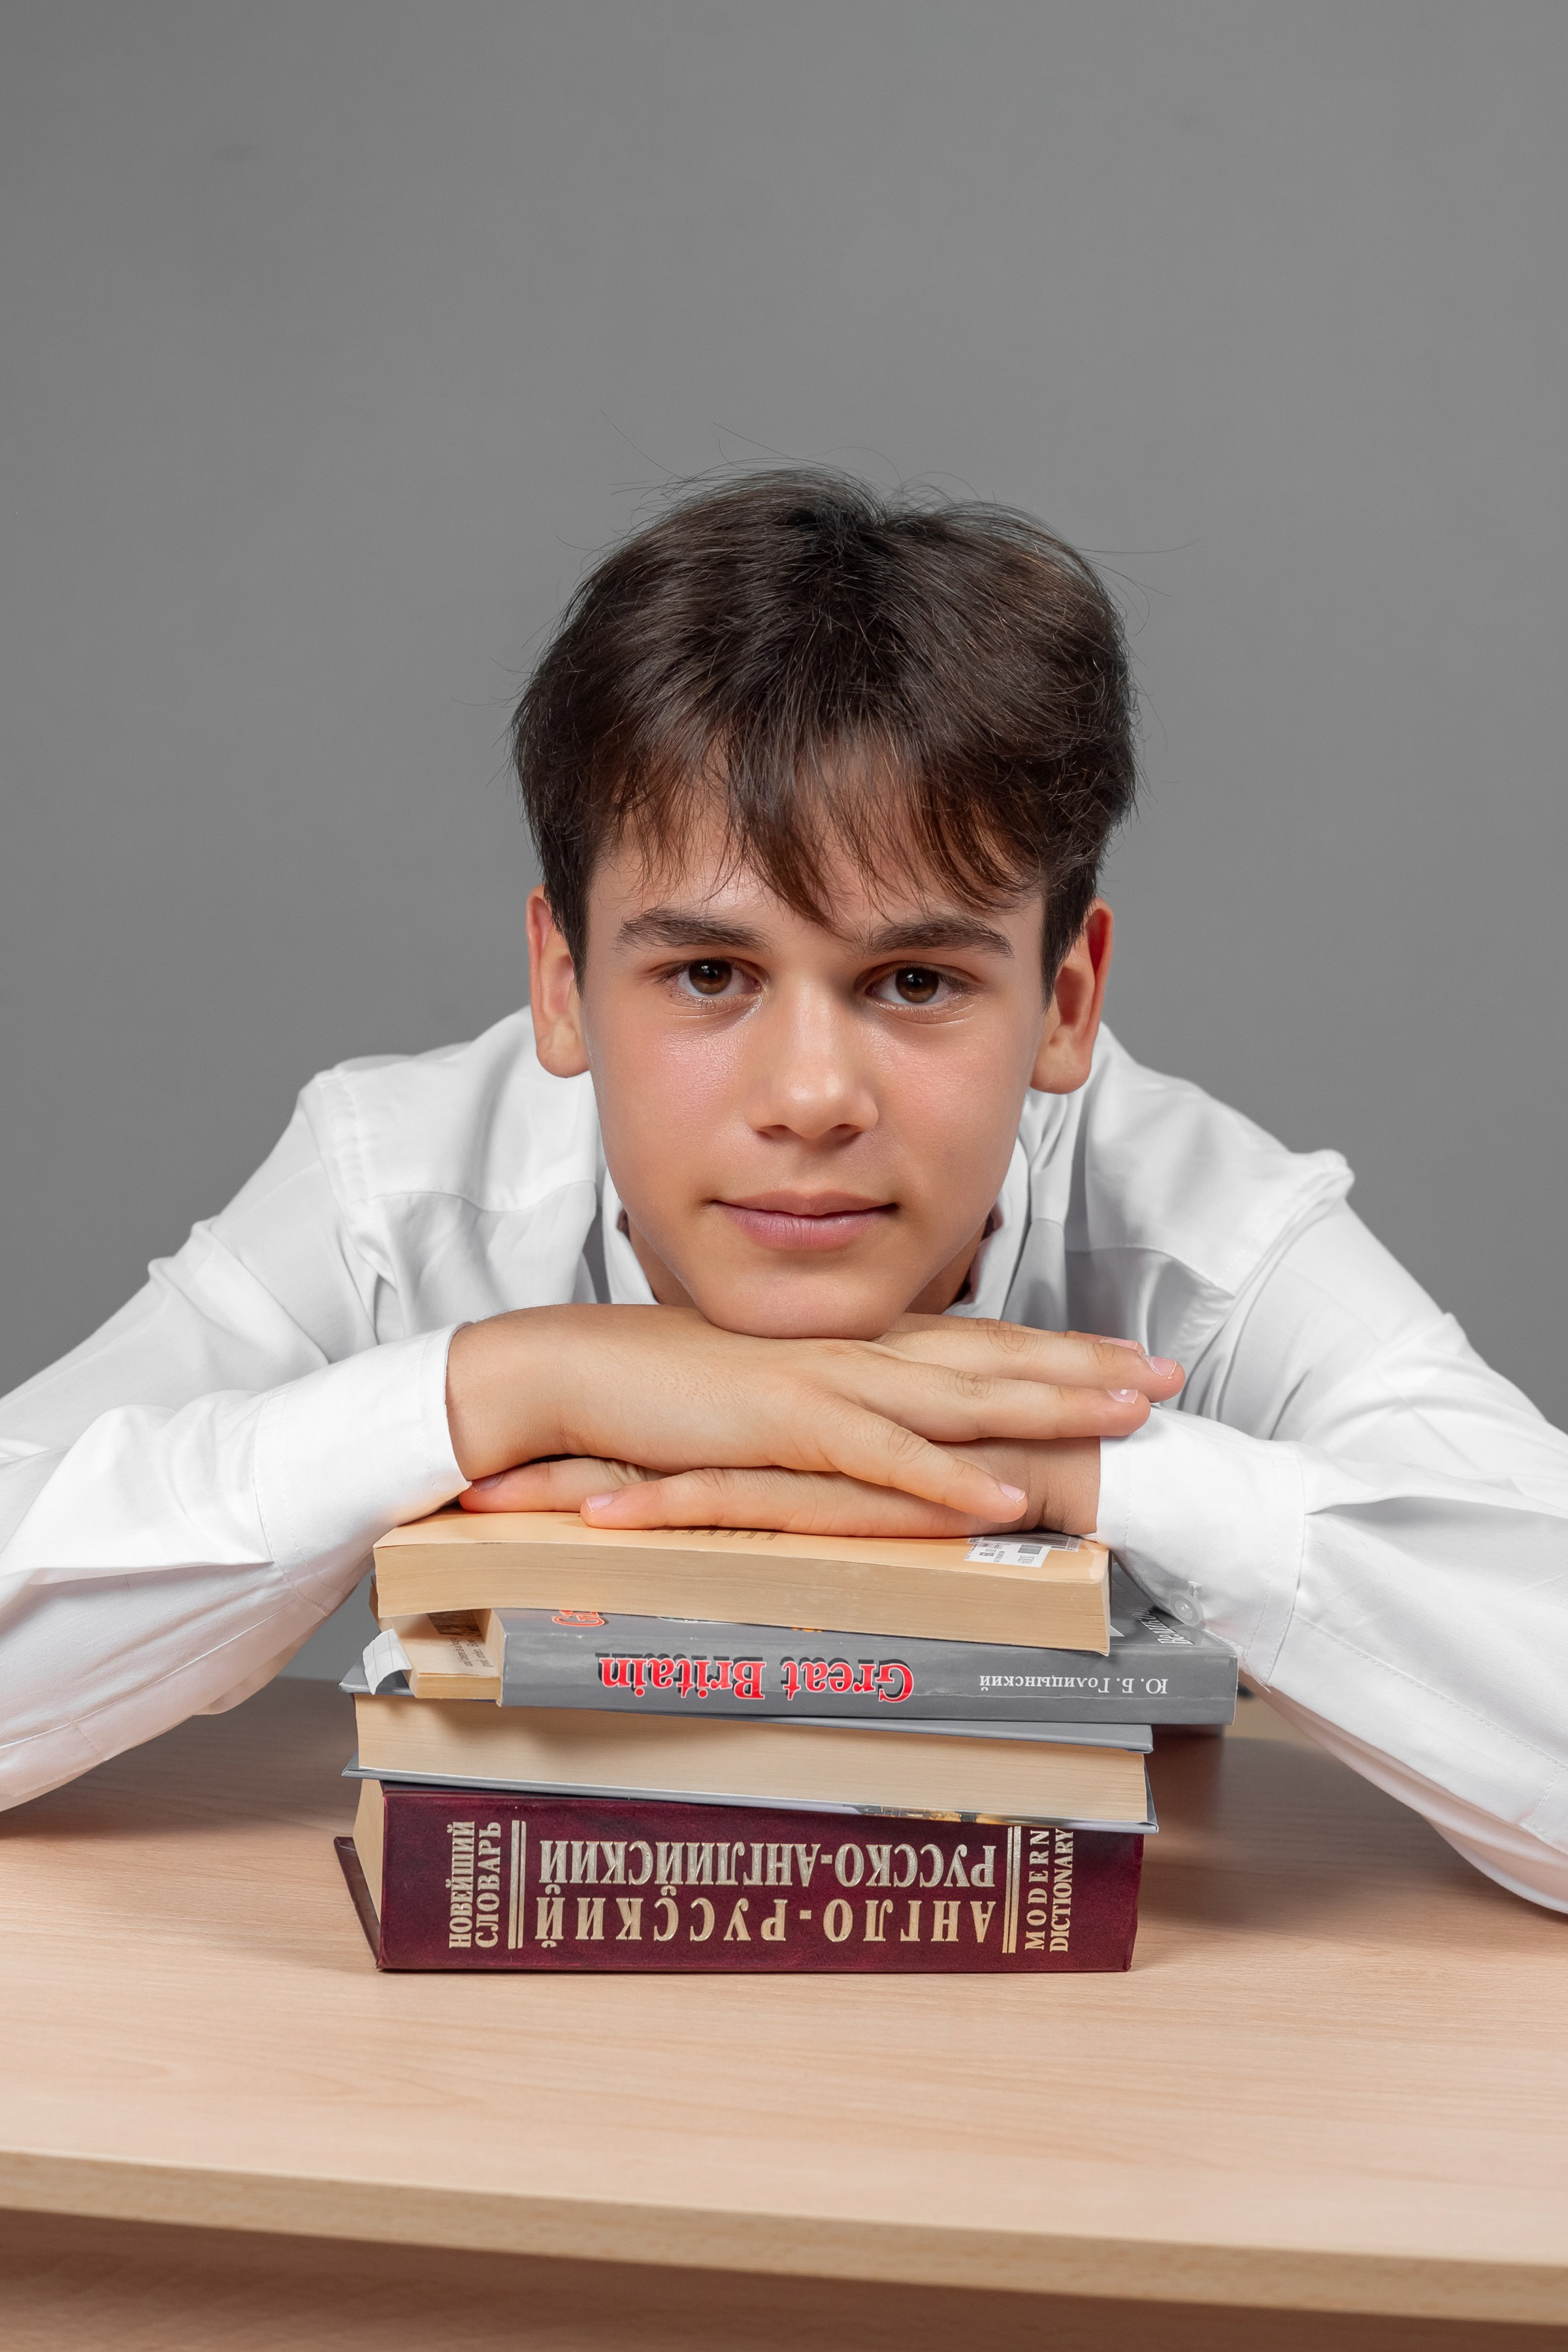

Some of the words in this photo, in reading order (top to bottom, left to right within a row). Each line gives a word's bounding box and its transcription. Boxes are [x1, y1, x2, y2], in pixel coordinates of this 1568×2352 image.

[598, 1656, 766, 1701] Britain
[781, 1659, 915, 1704] Great
[979, 1674, 1111, 1694] Голицынский
[1116, 1677, 1135, 1694] Б.
[1140, 1678, 1169, 1695] Ю.
[445, 1821, 476, 1949] НОВЕЙШИЙ
[474, 1821, 502, 1948] СЛОВАРЬ
[538, 1839, 997, 1897] РУССКО-АНГЛИЙСКИЙ
[1024, 1829, 1050, 1950] MODERN
[1049, 1827, 1074, 1952] DICTIONARY
